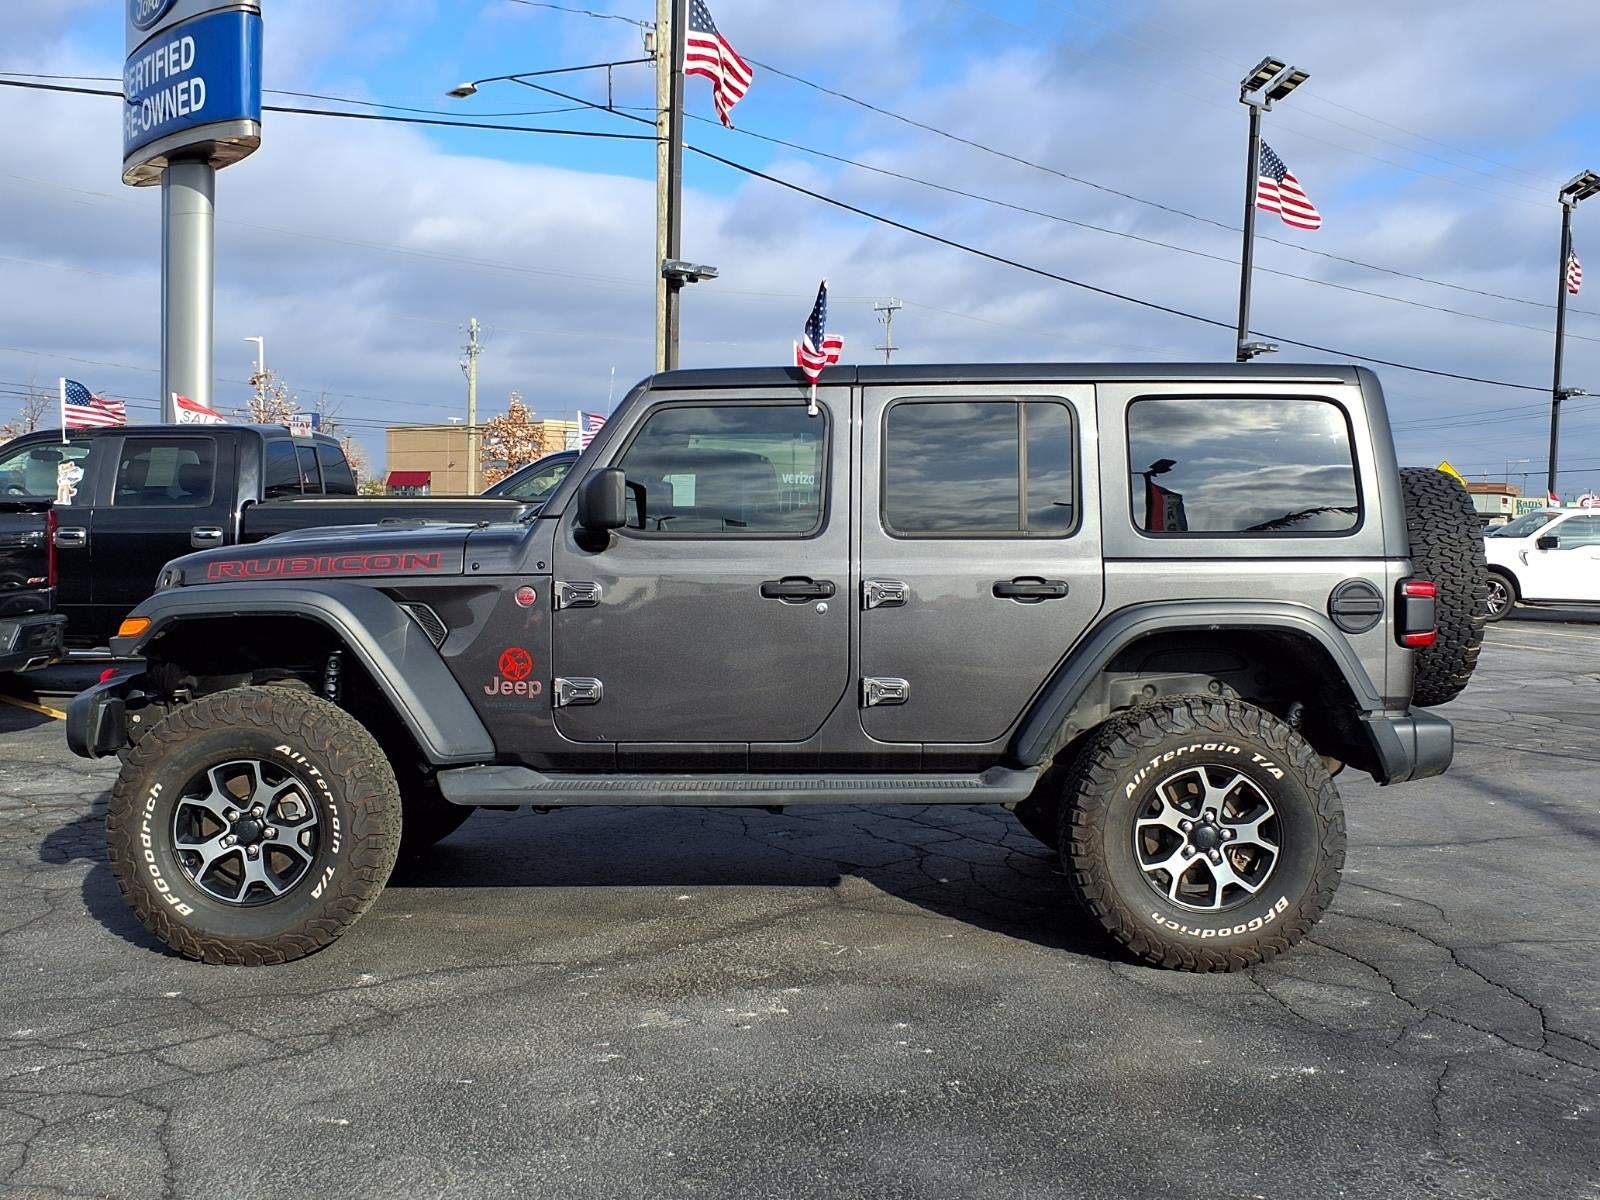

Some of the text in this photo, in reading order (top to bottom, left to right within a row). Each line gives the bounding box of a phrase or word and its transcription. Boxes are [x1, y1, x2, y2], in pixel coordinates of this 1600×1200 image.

[125, 35, 195, 98] ERTIFIED
[124, 76, 206, 142] RE-OWNED
[180, 410, 222, 424] SAL
[207, 552, 441, 580] RUBICON
[484, 676, 542, 699] Jeep
[1125, 742, 1285, 798] All-Terrain T/A
[140, 782, 194, 916] BFGoodrich
[274, 744, 342, 899] All-Terrain T/A
[1151, 895, 1289, 939] BFGoodrich
